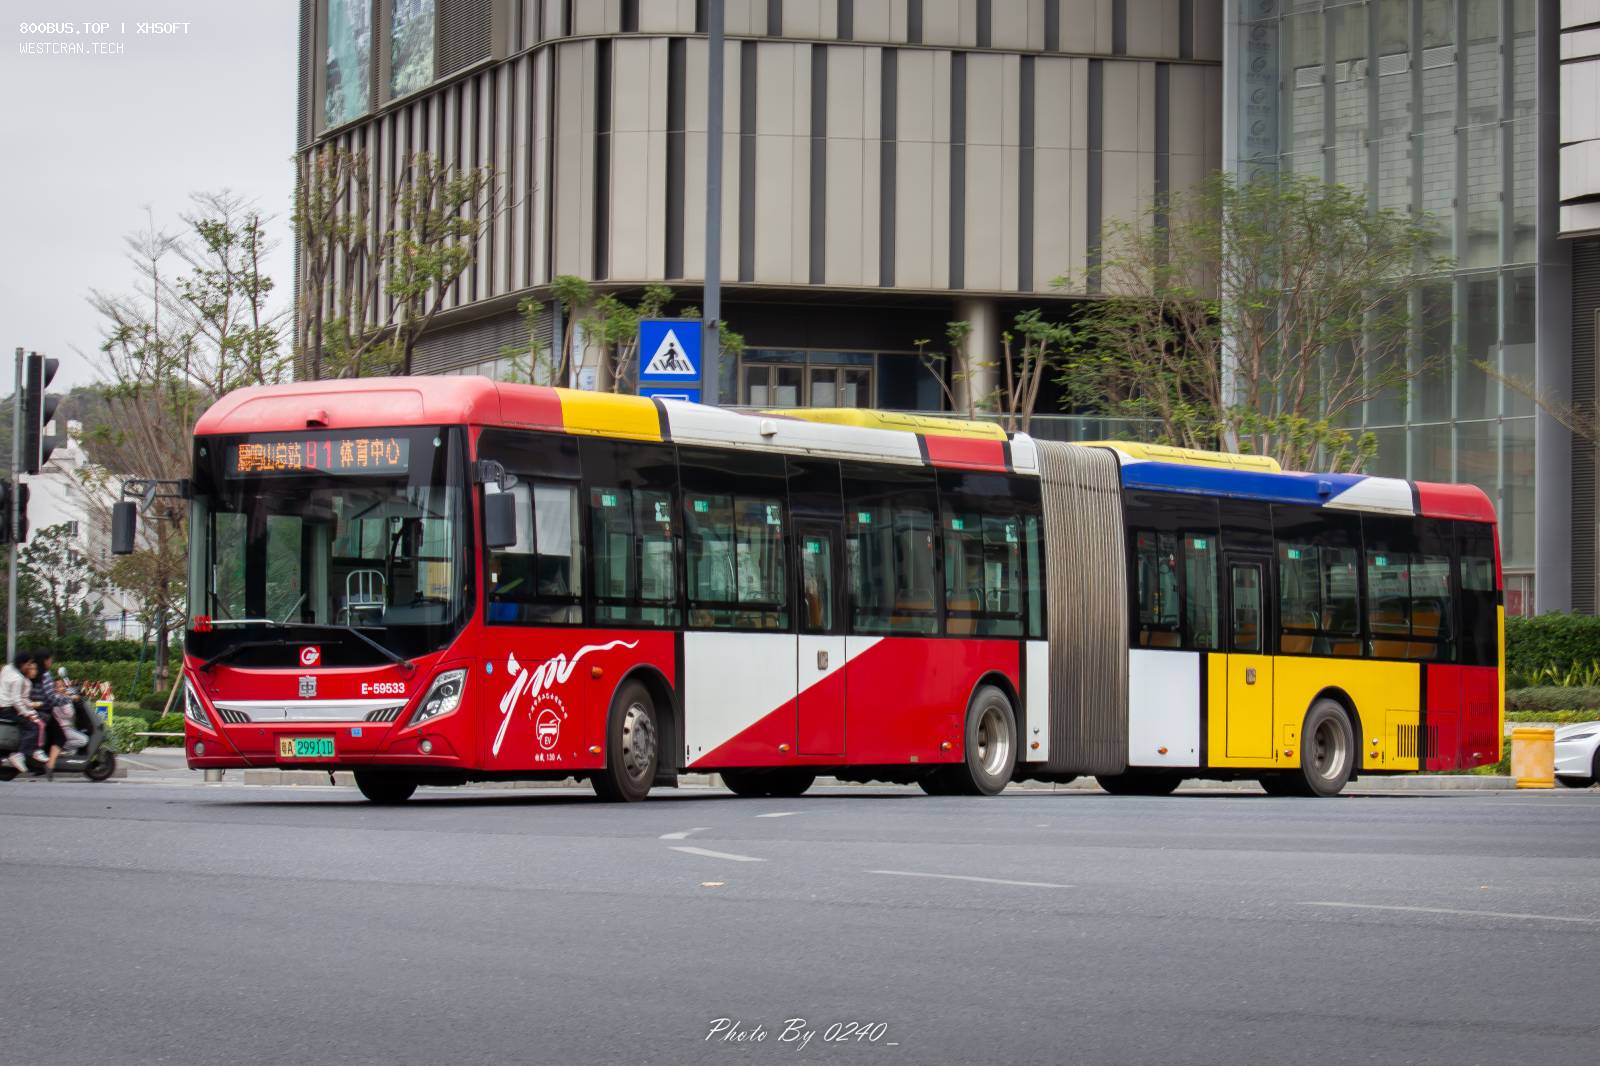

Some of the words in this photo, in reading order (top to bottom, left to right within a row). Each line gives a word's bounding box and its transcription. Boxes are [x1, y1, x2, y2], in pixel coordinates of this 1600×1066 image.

[339, 437, 400, 468] 体育中心
[361, 682, 406, 695] E-59533
[544, 735, 552, 745] EV
